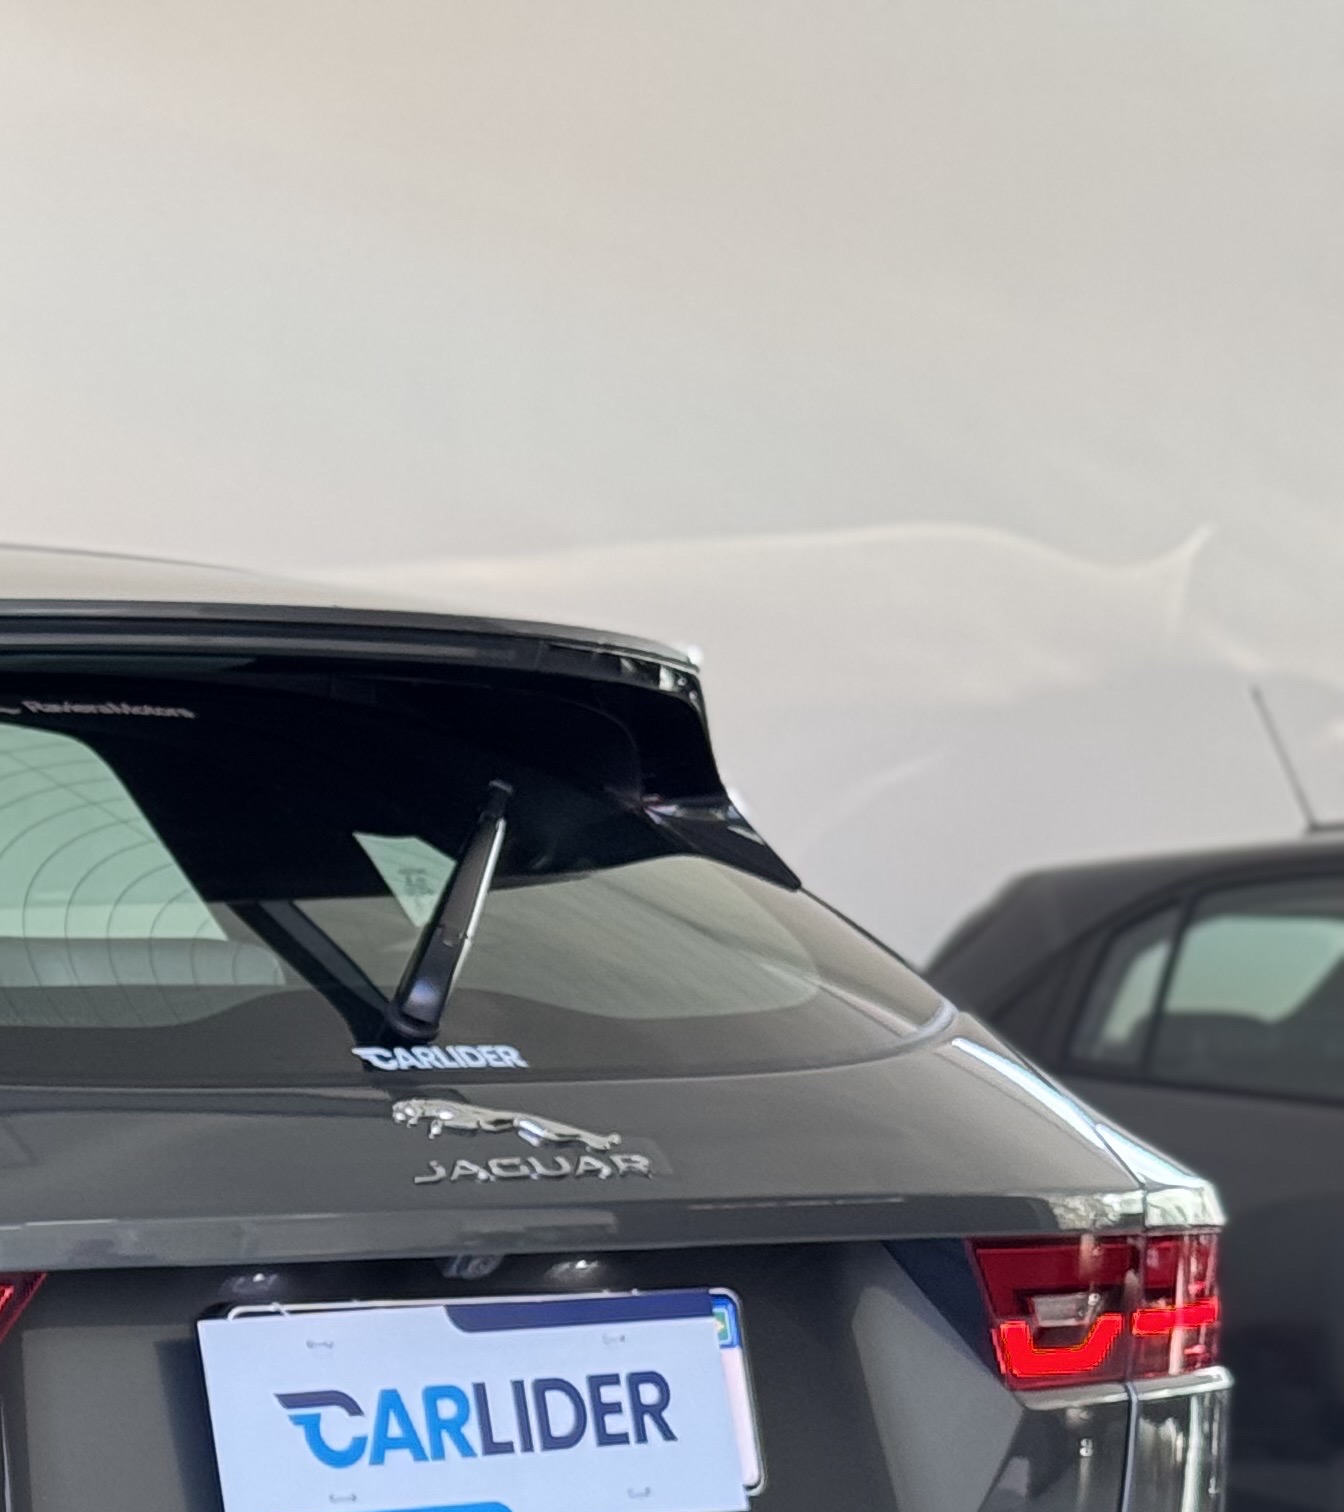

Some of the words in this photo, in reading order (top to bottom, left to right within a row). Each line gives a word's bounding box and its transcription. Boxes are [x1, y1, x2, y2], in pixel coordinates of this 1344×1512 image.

[351, 1045, 529, 1071] CARLIDER
[414, 1154, 654, 1185] JAGUAR
[273, 1370, 678, 1469] CARLIDER
